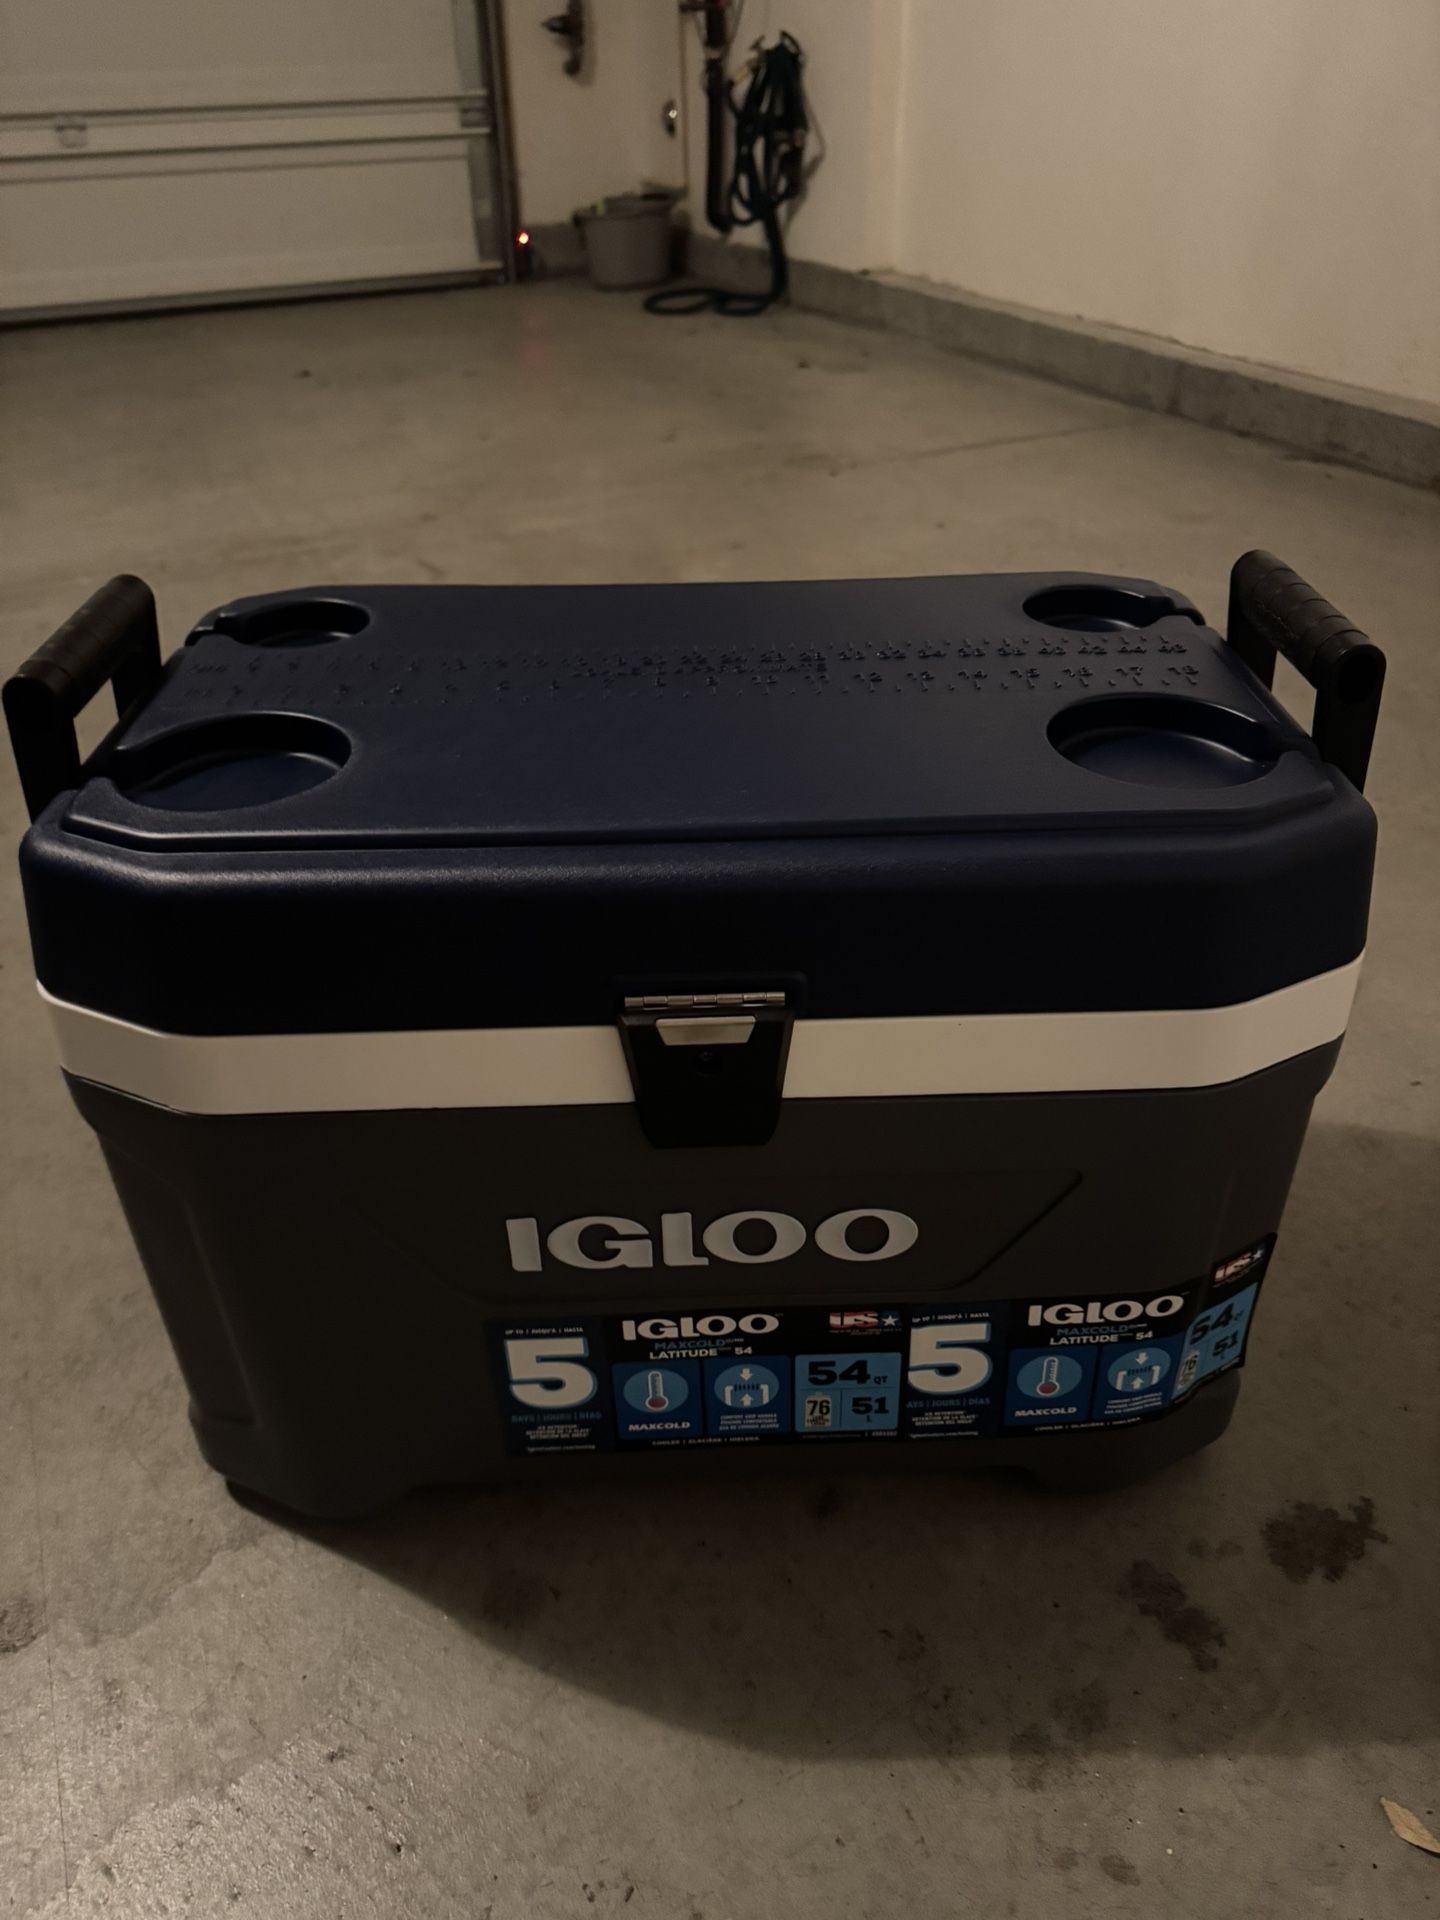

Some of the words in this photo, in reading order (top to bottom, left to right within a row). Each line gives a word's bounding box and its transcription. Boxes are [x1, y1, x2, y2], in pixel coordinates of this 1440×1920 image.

[505, 1208, 919, 1273] IGLOO
[1027, 1295, 1185, 1327] IGLOO
[622, 1313, 781, 1341] IGLOO
[1056, 1325, 1130, 1336] MAXCOLD
[1190, 1303, 1235, 1345] 54
[654, 1338, 726, 1351] MAXCOLD
[1049, 1333, 1119, 1346] LATITUDE
[1135, 1330, 1154, 1341] 54
[649, 1348, 718, 1360] LATITUDE
[735, 1346, 753, 1356] 54
[908, 1322, 993, 1395] 5
[504, 1337, 597, 1409] 5
[808, 1360, 871, 1386] 54
[873, 1375, 888, 1385] QT
[807, 1400, 831, 1416] 76
[852, 1396, 889, 1415] 51
[1014, 1406, 1078, 1417] MAXCOLD
[628, 1421, 691, 1432] MAXCOLD
